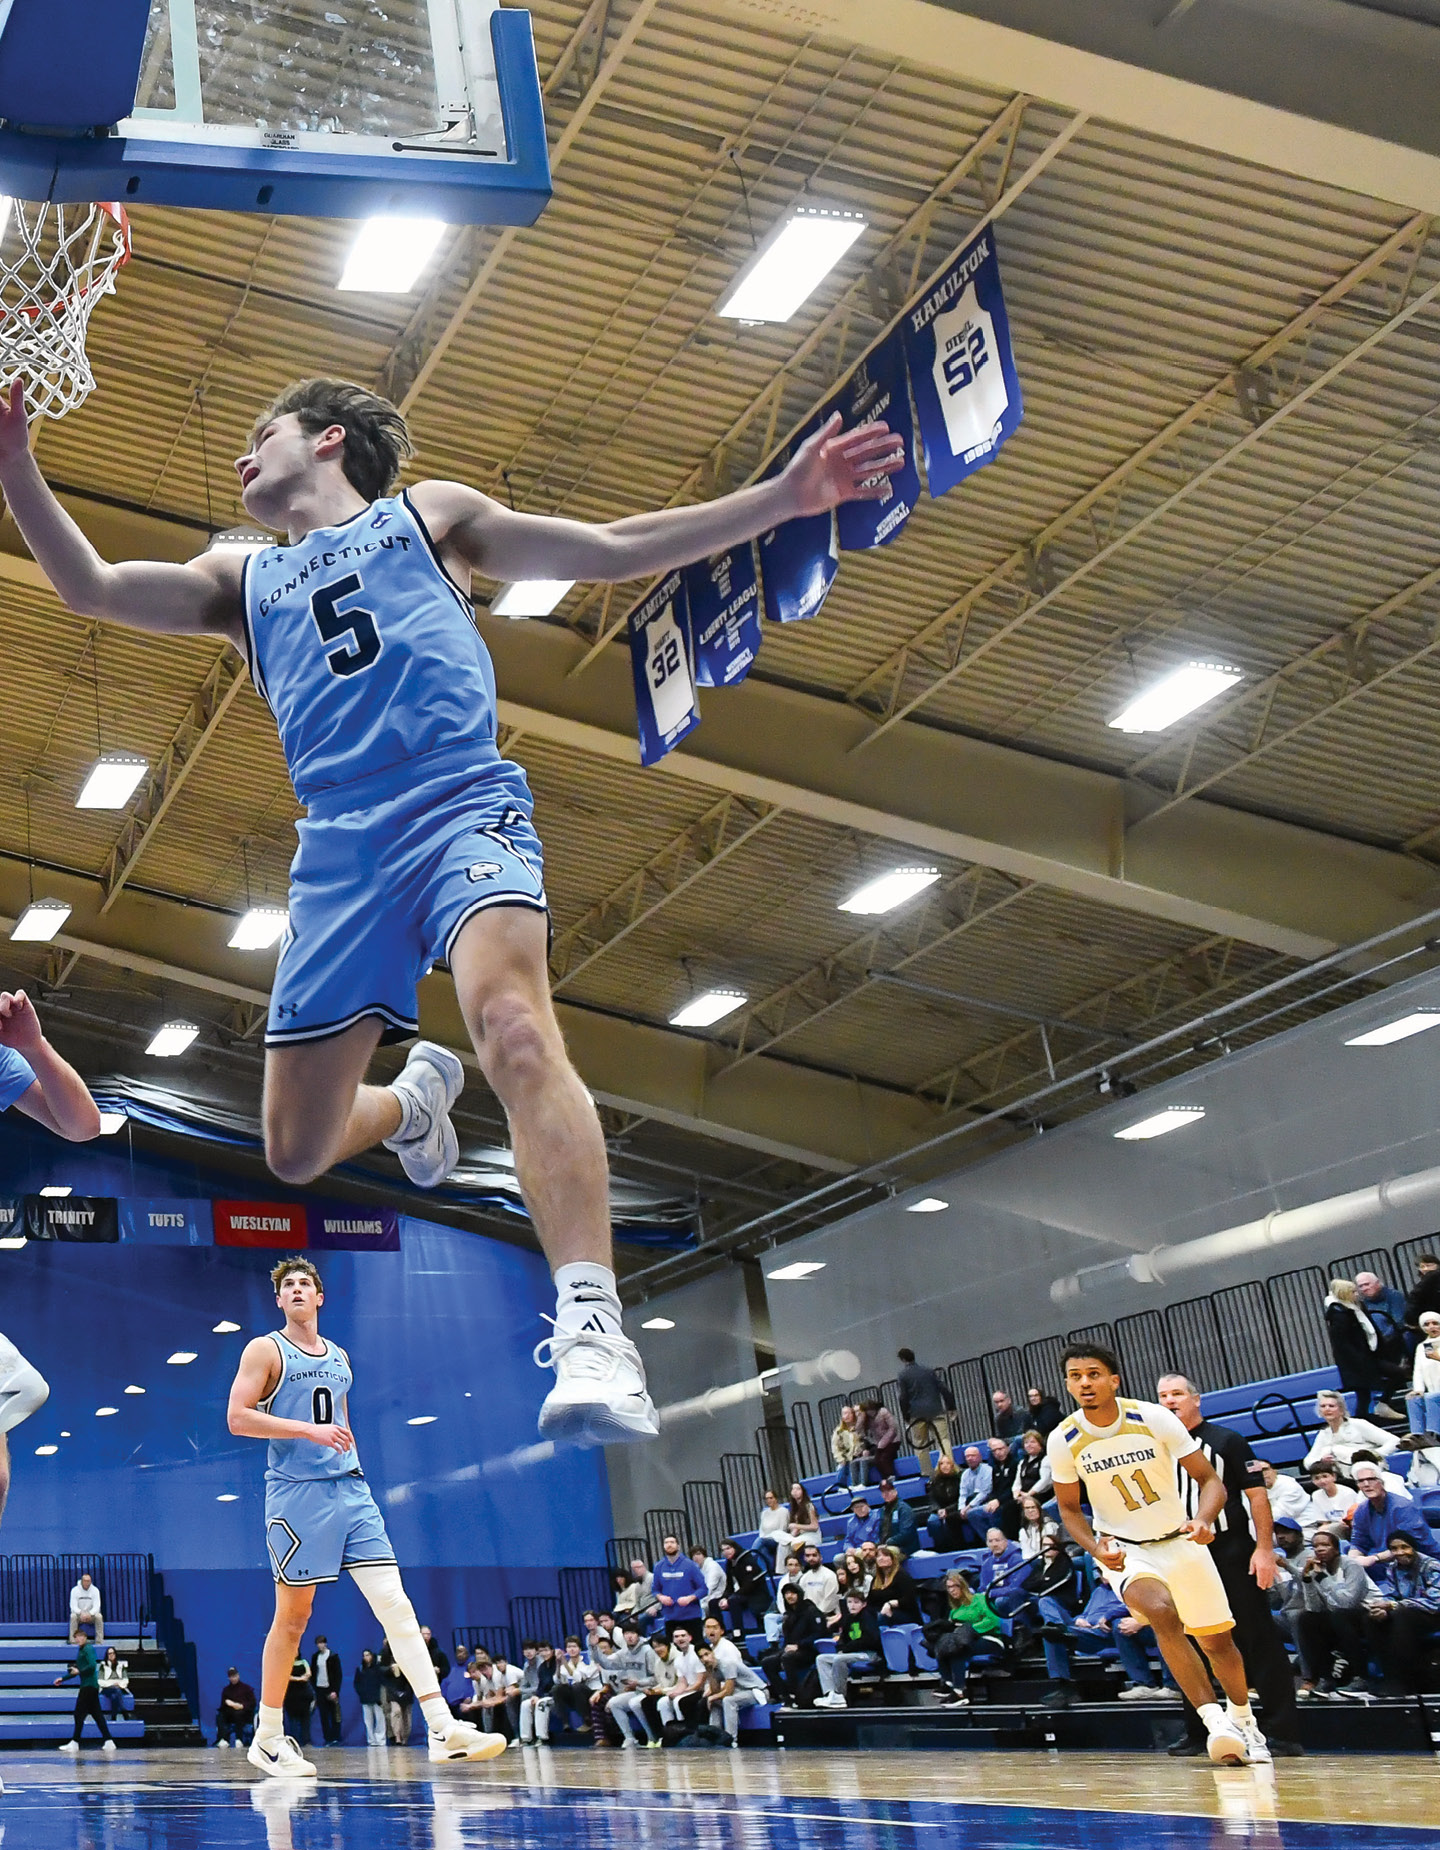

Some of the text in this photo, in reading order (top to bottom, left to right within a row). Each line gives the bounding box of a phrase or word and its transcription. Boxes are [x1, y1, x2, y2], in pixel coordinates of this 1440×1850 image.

[911, 238, 990, 333] HAMILTON
[942, 326, 989, 397] 52
[258, 535, 413, 618] CONNECTICUT
[309, 569, 385, 681] 5
[651, 637, 682, 690] 32
[47, 1209, 96, 1226] TRINITY
[147, 1213, 185, 1228] TUFTS
[229, 1215, 291, 1232] WESLEYAN
[323, 1219, 383, 1235] WILLIAMS
[288, 1370, 349, 1385] CONNECTICUT
[311, 1385, 335, 1425] 0
[1082, 1447, 1157, 1475] HAMILTON
[1109, 1468, 1162, 1512] 11
